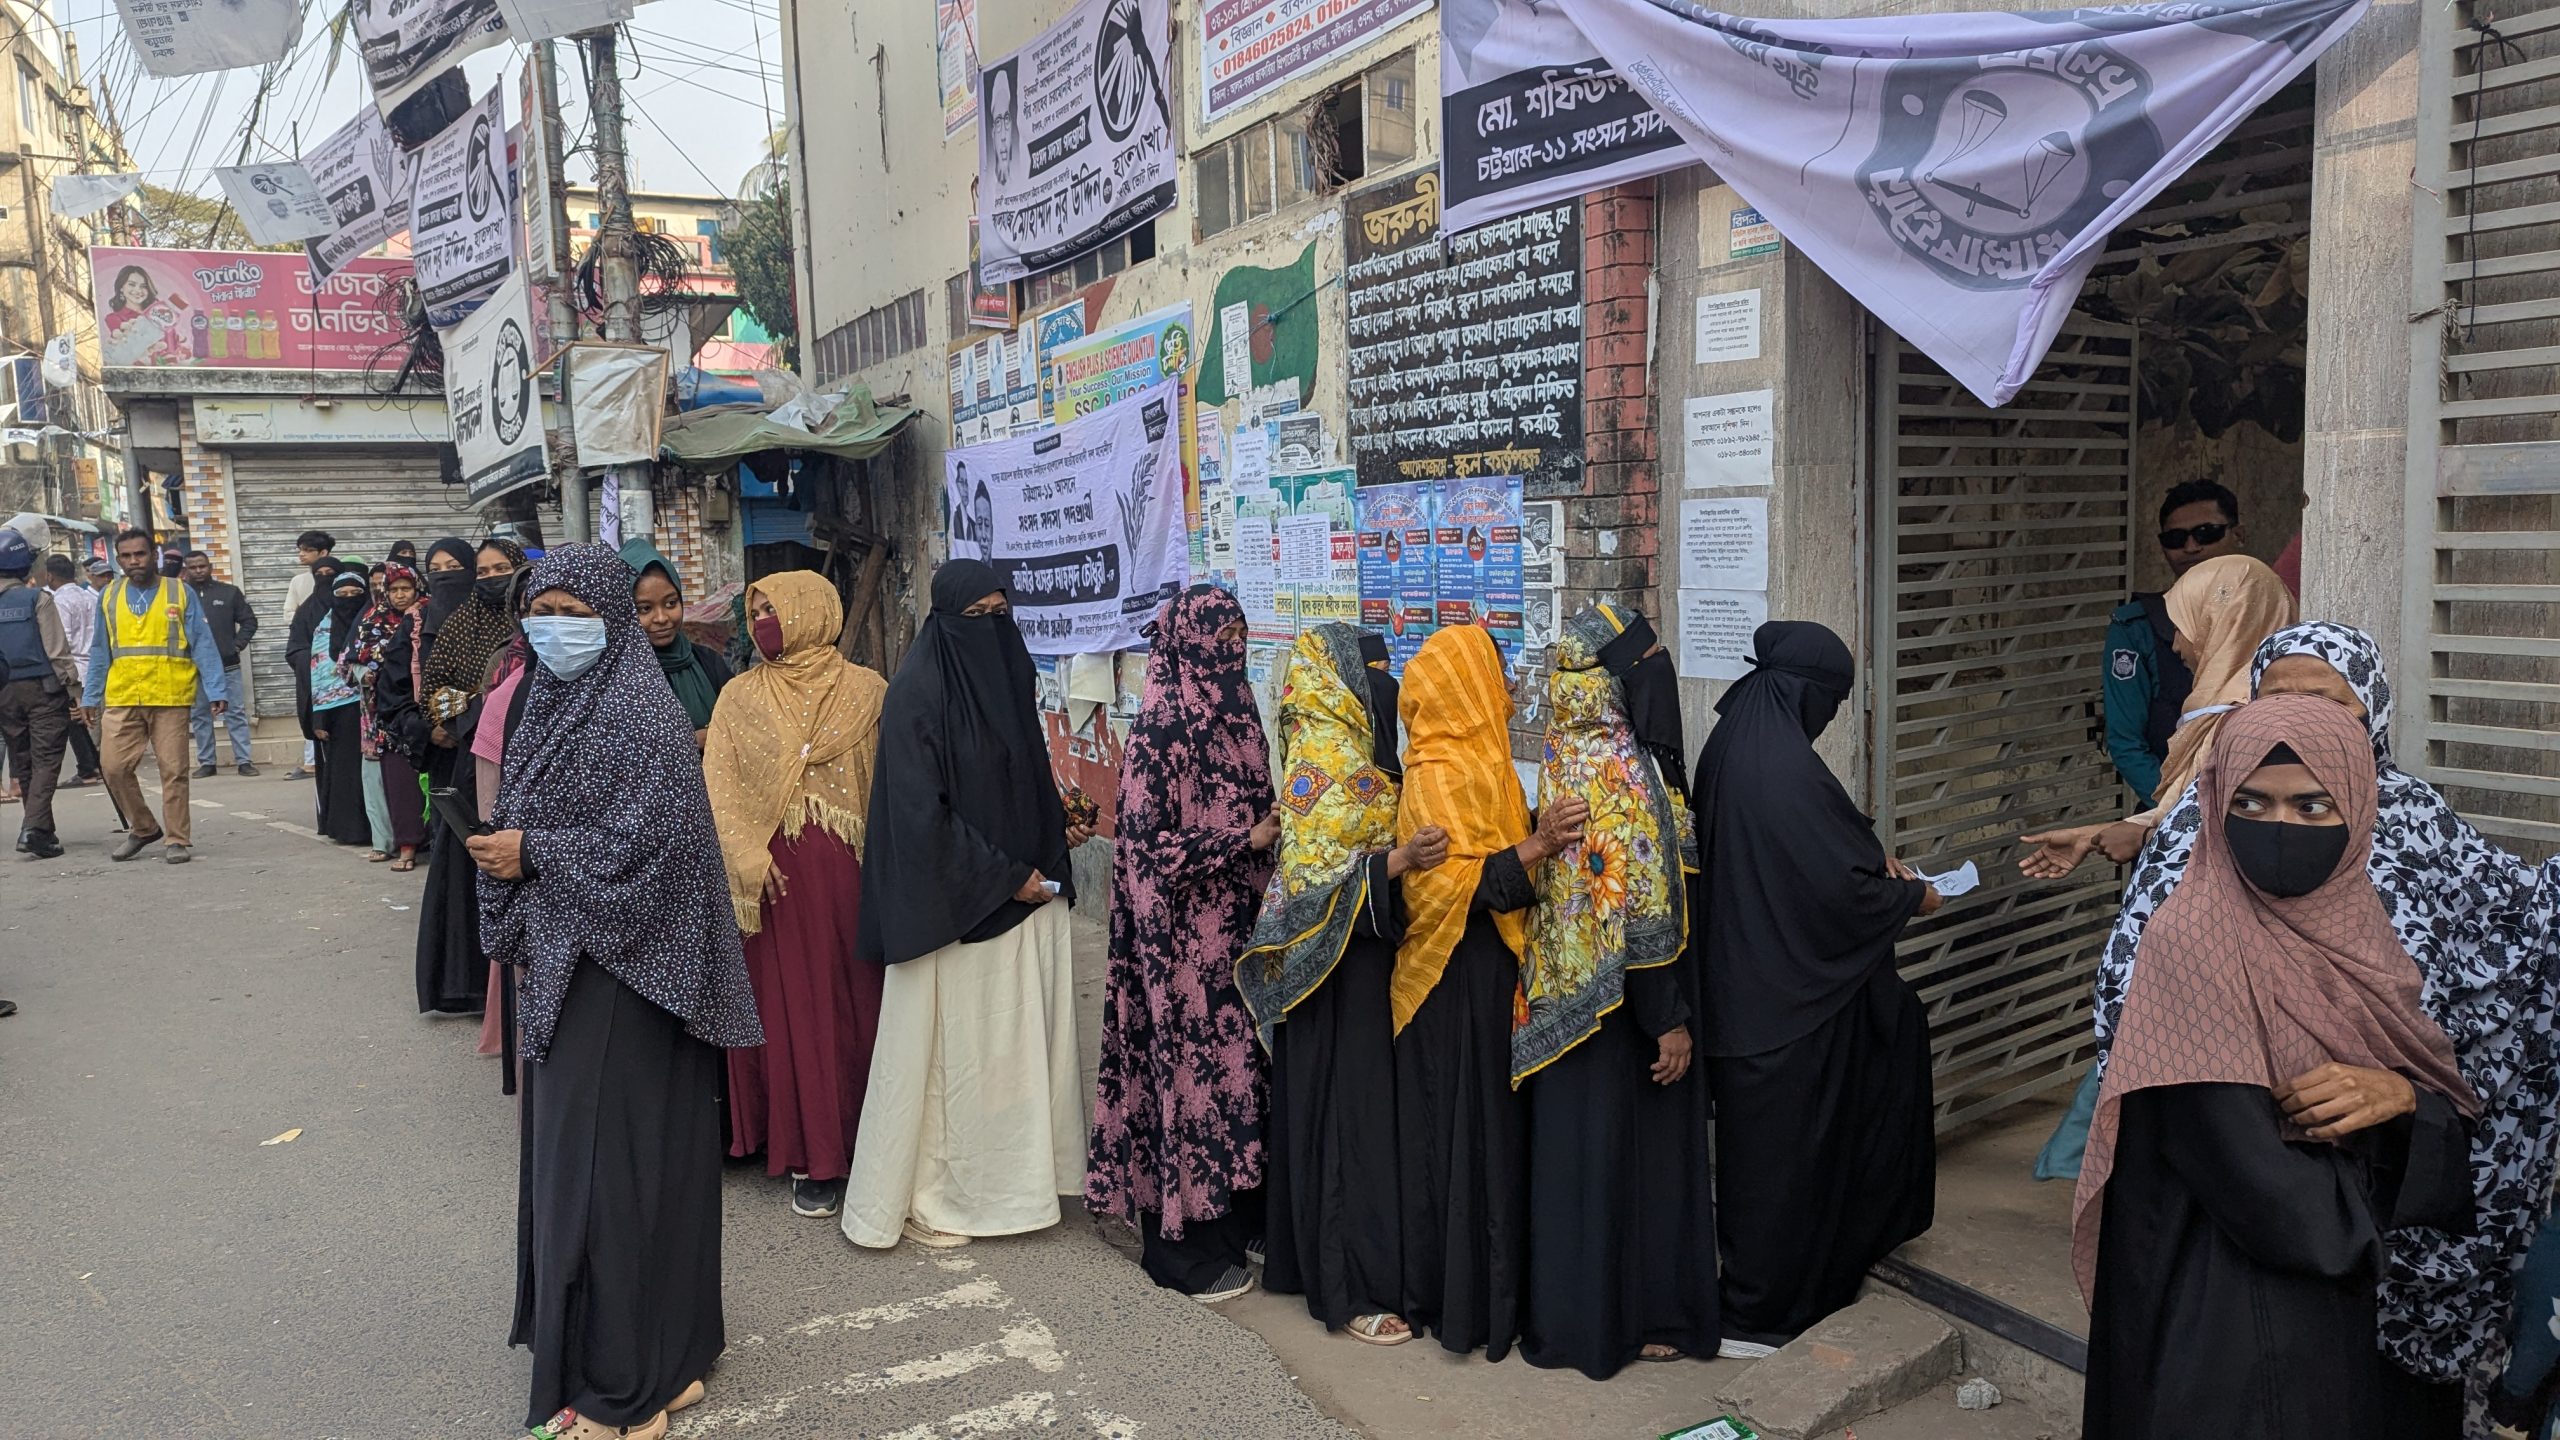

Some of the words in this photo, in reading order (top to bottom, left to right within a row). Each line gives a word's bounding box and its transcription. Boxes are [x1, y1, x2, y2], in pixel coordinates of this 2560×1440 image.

[1230, 16, 1264, 48] বিজ্ঞান
[1477, 96, 1518, 138] মো.
[1032, 147, 1048, 169] সংসদ
[1047, 137, 1062, 161] সদস্য
[1477, 137, 1567, 182] চট্টগ্রাম-১১
[1571, 118, 1627, 155] সংসদ
[1012, 196, 1052, 242] মোহাম্মদ
[1054, 188, 1068, 237] নূর
[1070, 162, 1101, 216] উদ্দিন
[1363, 175, 1440, 246] জরুরী
[1732, 213, 1758, 229] রিপন
[473, 217, 504, 249] হাতপাখা
[1455, 230, 1479, 254] জন্য
[1479, 215, 1521, 248] জানানো
[1556, 206, 1571, 233] যে
[195, 260, 262, 290] Drinko
[1397, 278, 1408, 300] যে
[1409, 269, 1435, 298] কোন
[1436, 266, 1459, 287] সময়
[1461, 248, 1515, 288] ঘোরাফেরা
[1516, 245, 1530, 267] বা
[1532, 240, 1560, 265] বসে
[1373, 307, 1394, 335] দেয়া
[1457, 291, 1479, 320] স্কুল
[1481, 271, 1536, 307] চলাকালীন
[1539, 270, 1575, 296] সময়ে
[1404, 336, 1410, 357] ও
[1462, 318, 1492, 346] অযথা
[1494, 306, 1552, 345] ঘোরাফেরা
[1553, 301, 1580, 329] করা
[1066, 358, 1087, 383] ENGLISH
[1087, 352, 1100, 376] PLUS
[1104, 342, 1127, 372] SCIENCE
[1127, 333, 1155, 365] QUANTUM
[1350, 376, 1367, 399] যাবে
[1378, 362, 1404, 393] আইন
[1461, 349, 1498, 380] বিরুদ্ধে
[1499, 344, 1541, 378] কর্তৃপক্ষ
[1542, 341, 1579, 367] যথাযথ
[1070, 386, 1082, 398] Your
[1112, 375, 1123, 387] Our
[1124, 366, 1152, 381] Mission
[1490, 379, 1533, 411] পরিবেশ
[1534, 371, 1577, 403] নিশ্চিত
[1426, 412, 1479, 448] সহযোগিতা
[1519, 404, 1561, 438] করছি
[1692, 410, 1711, 419] আপনার
[1700, 423, 1721, 435] কুরআনে
[1722, 420, 1738, 432] সুশিক্ষা
[1453, 453, 1482, 479] স্কুল
[1483, 441, 1540, 476] কর্তৃপক্ষ
[1054, 476, 1076, 495] আসনে
[1018, 514, 1039, 532] সংসদ
[1040, 508, 1061, 531] সদস্য
[1063, 488, 1094, 523] পদপ্রার্থী
[1012, 561, 1034, 595] আমীর
[1034, 568, 1054, 594] খসরু
[1054, 564, 1080, 598] মাহমুদ
[1081, 551, 1106, 595] চৌধুরী
